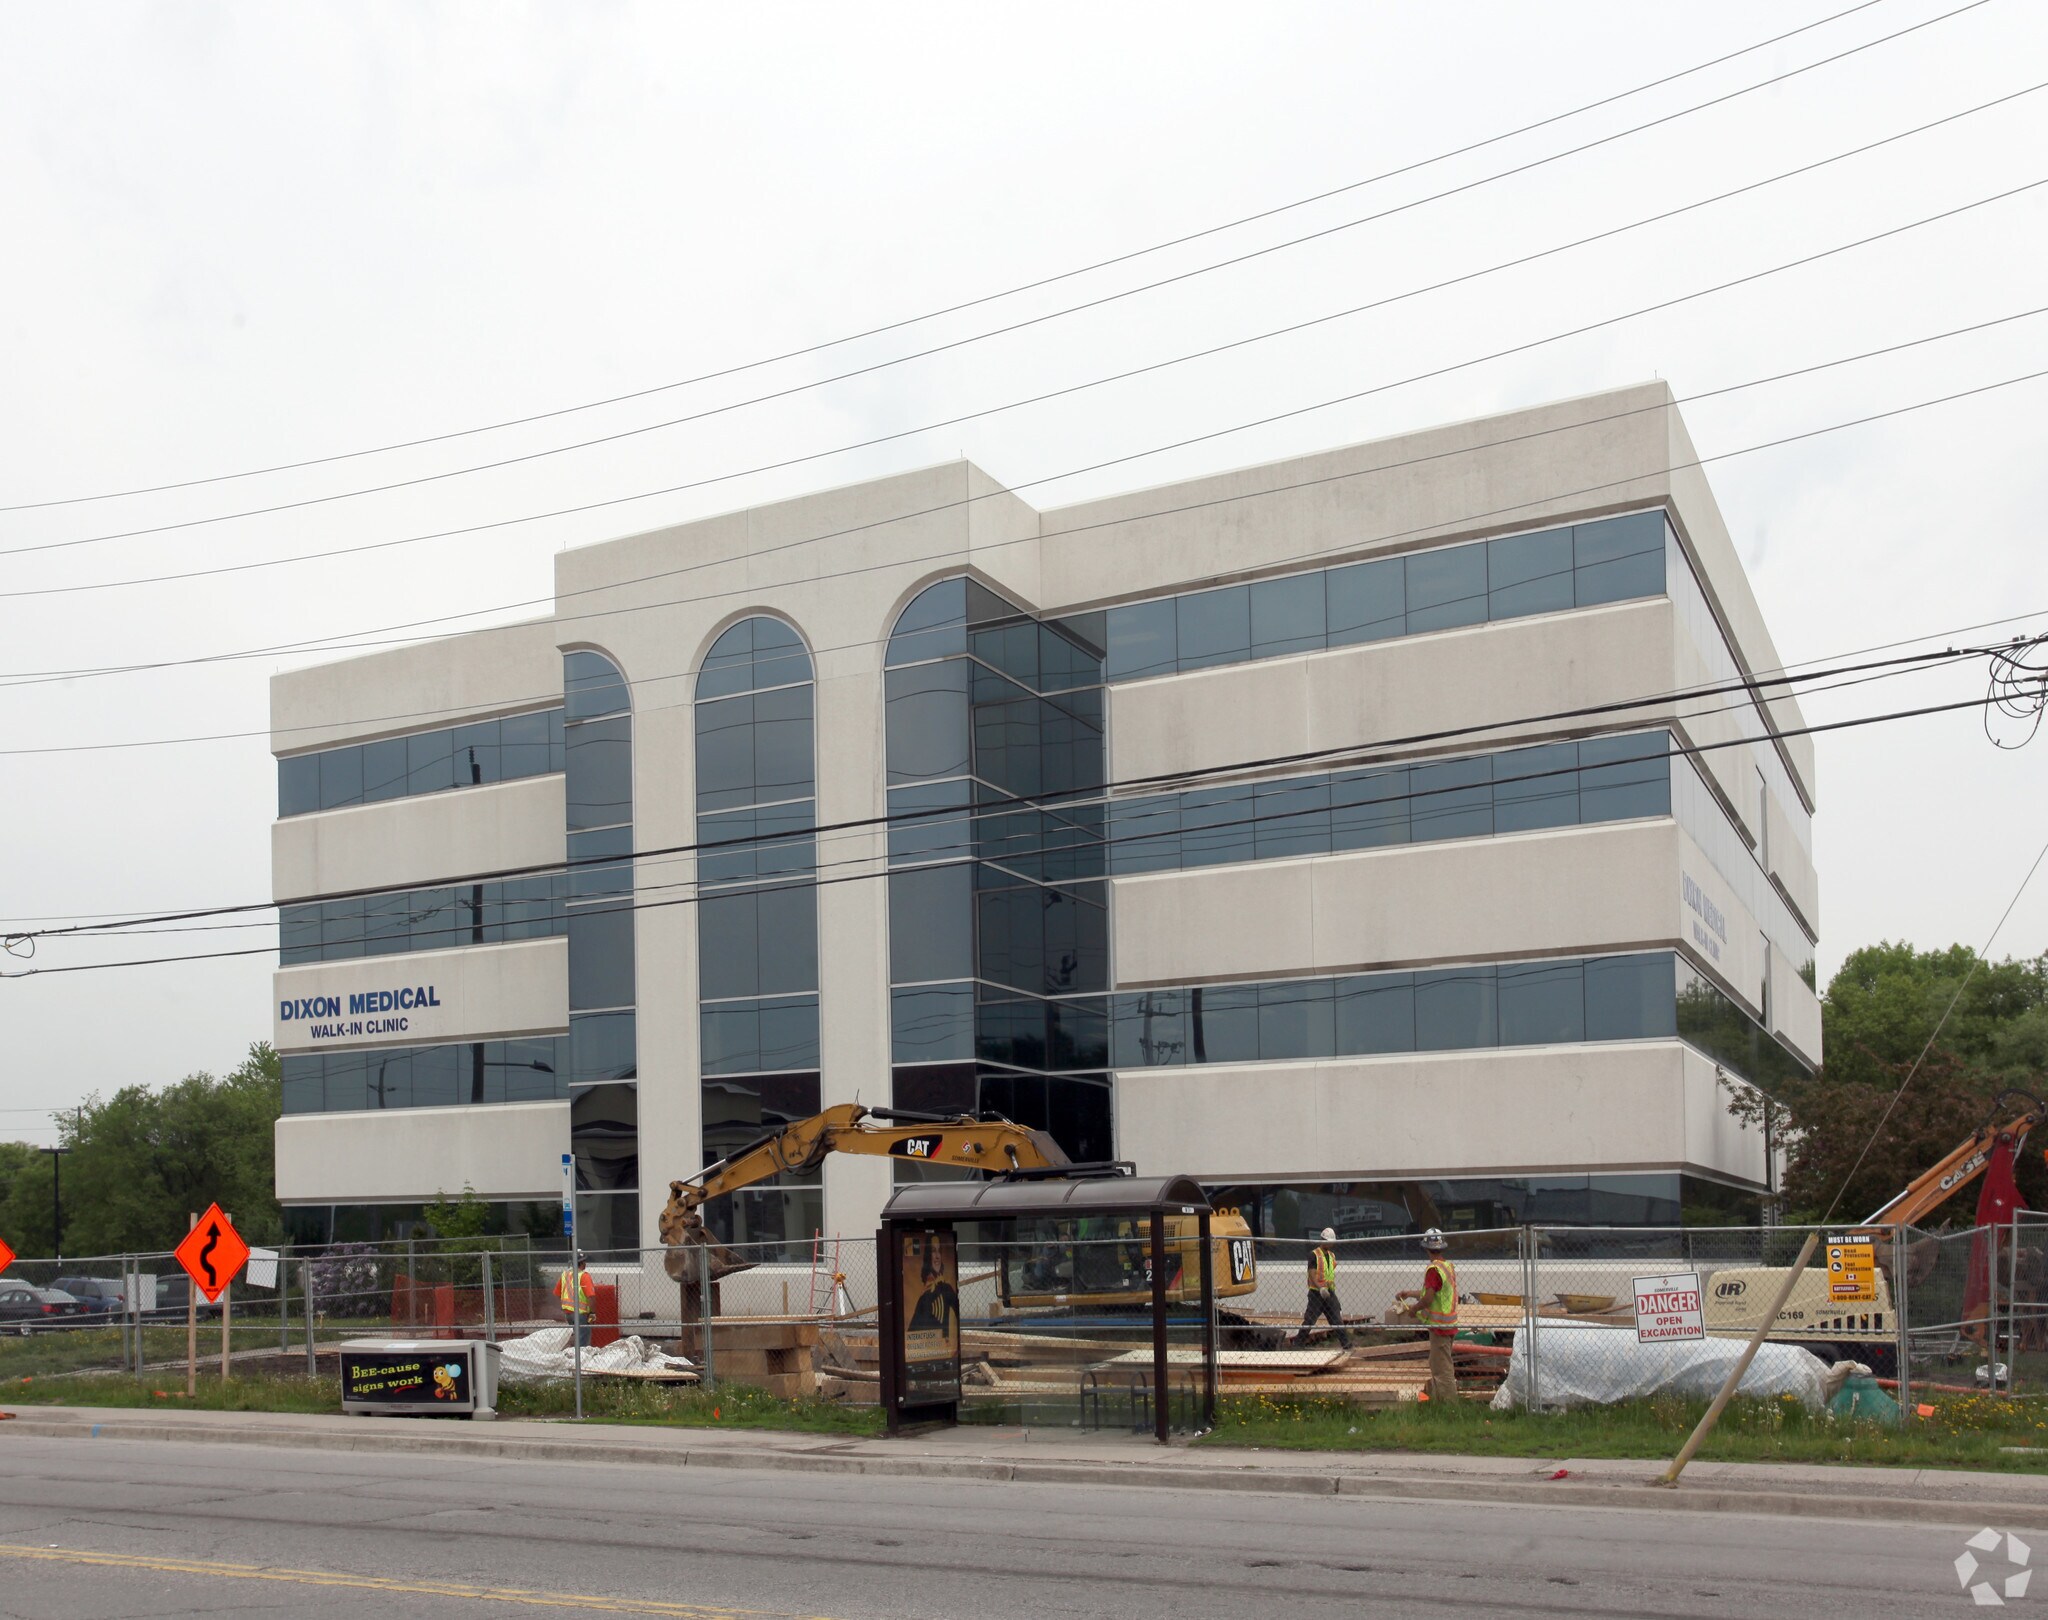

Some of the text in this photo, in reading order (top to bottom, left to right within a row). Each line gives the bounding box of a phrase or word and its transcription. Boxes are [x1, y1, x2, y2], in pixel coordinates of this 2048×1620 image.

[281, 986, 441, 1021] DIXON MEDICAL
[311, 1017, 408, 1039] WALK-IN CLINIC
[907, 1139, 930, 1157] CAT
[1940, 1150, 1986, 1190] CASE
[1828, 1236, 1844, 1244] MUST
[1852, 1235, 1870, 1243] WORN
[1233, 1240, 1254, 1281] CAT
[1720, 1283, 1741, 1296] IR
[1637, 1292, 1698, 1314] DANGER
[1656, 1316, 1683, 1326] OPEN
[1640, 1326, 1702, 1338] EXCAVATION
[352, 1376, 423, 1393] signs work
